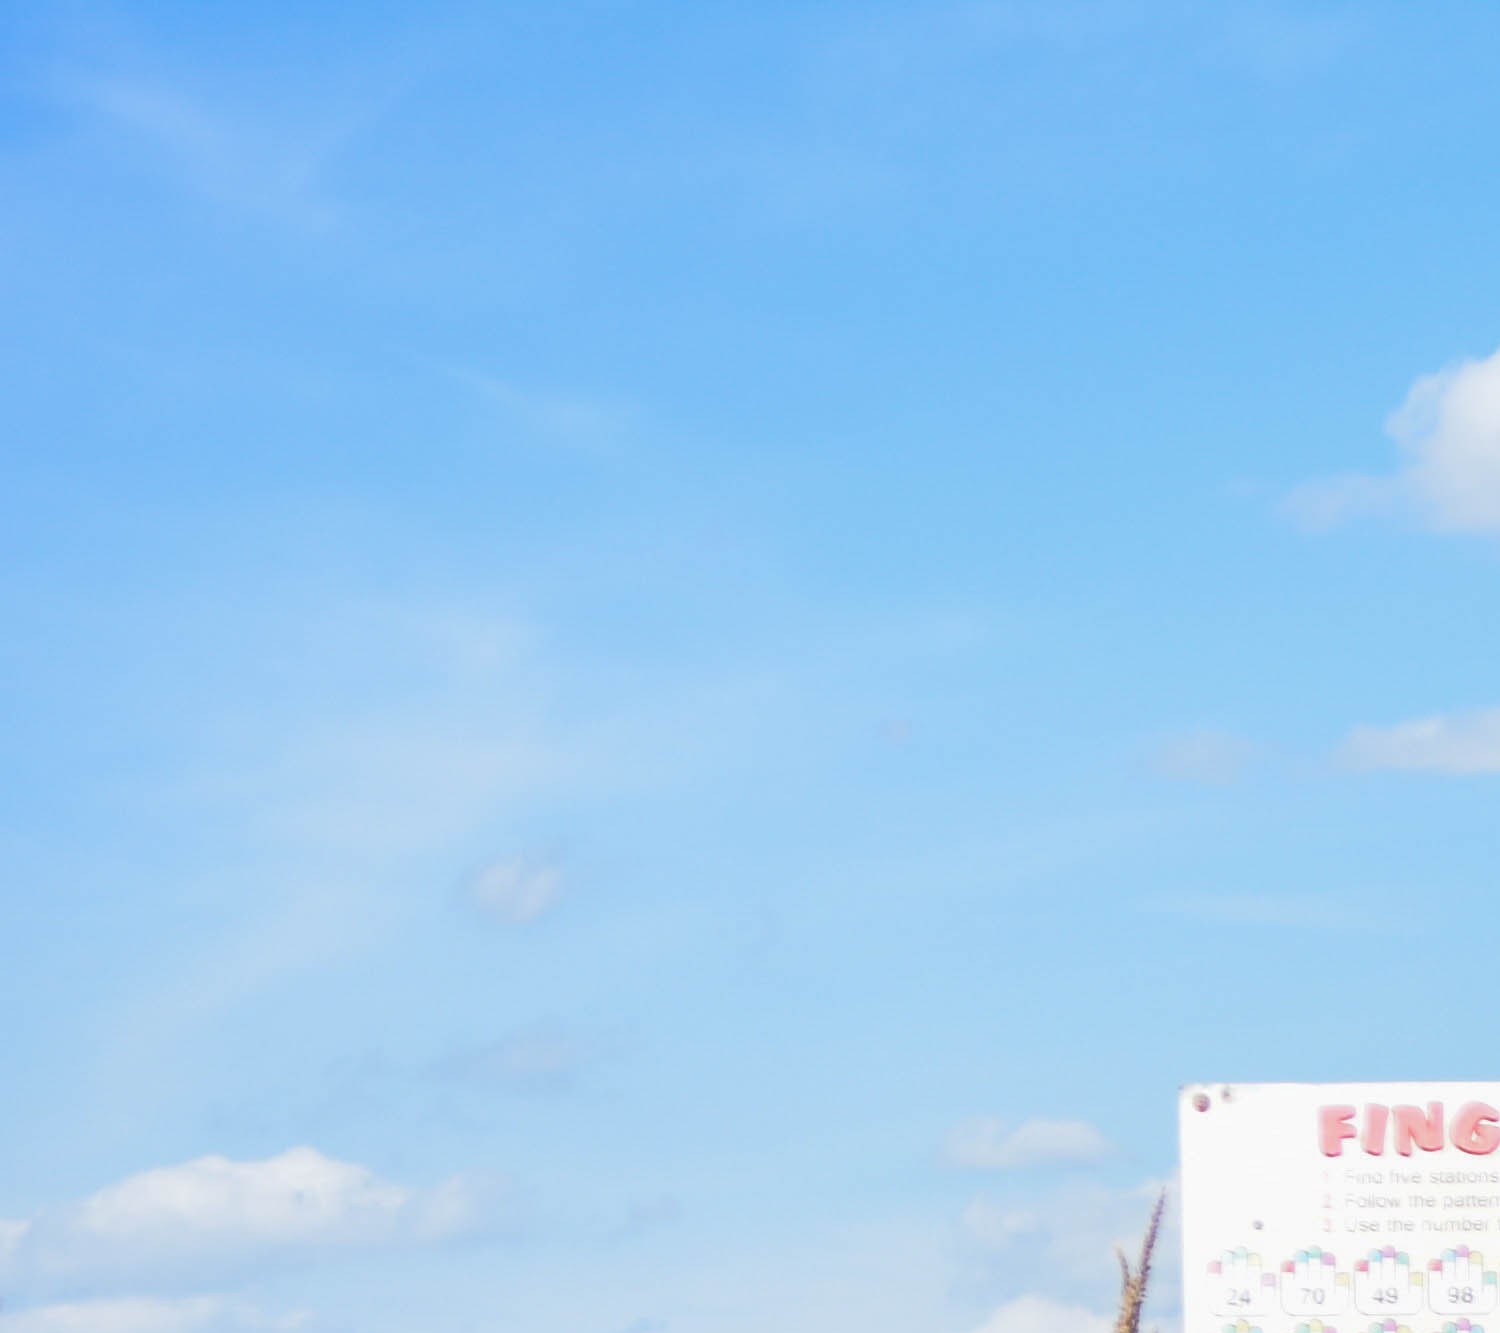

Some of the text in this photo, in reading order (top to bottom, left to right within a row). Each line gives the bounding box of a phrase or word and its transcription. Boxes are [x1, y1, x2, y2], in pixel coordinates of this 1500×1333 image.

[1301, 1288, 1326, 1305] 70
[1373, 1288, 1398, 1304] 49
[1449, 1287, 1474, 1304] 98
